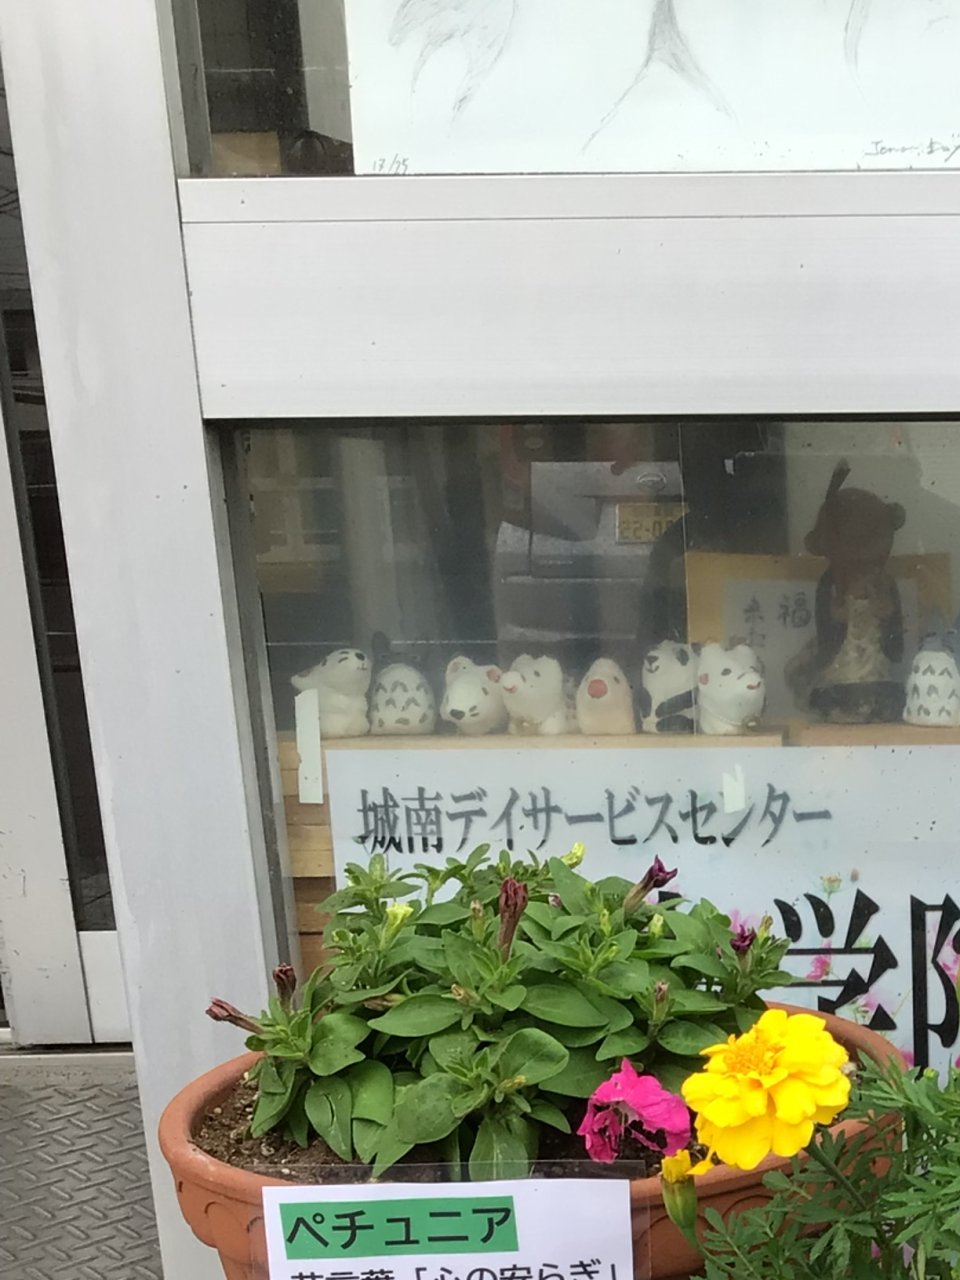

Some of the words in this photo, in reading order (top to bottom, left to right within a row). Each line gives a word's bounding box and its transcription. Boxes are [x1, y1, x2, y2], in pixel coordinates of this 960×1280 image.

[356, 782, 832, 854] 城南デイサービスセンター
[286, 1205, 513, 1250] ペチュニア
